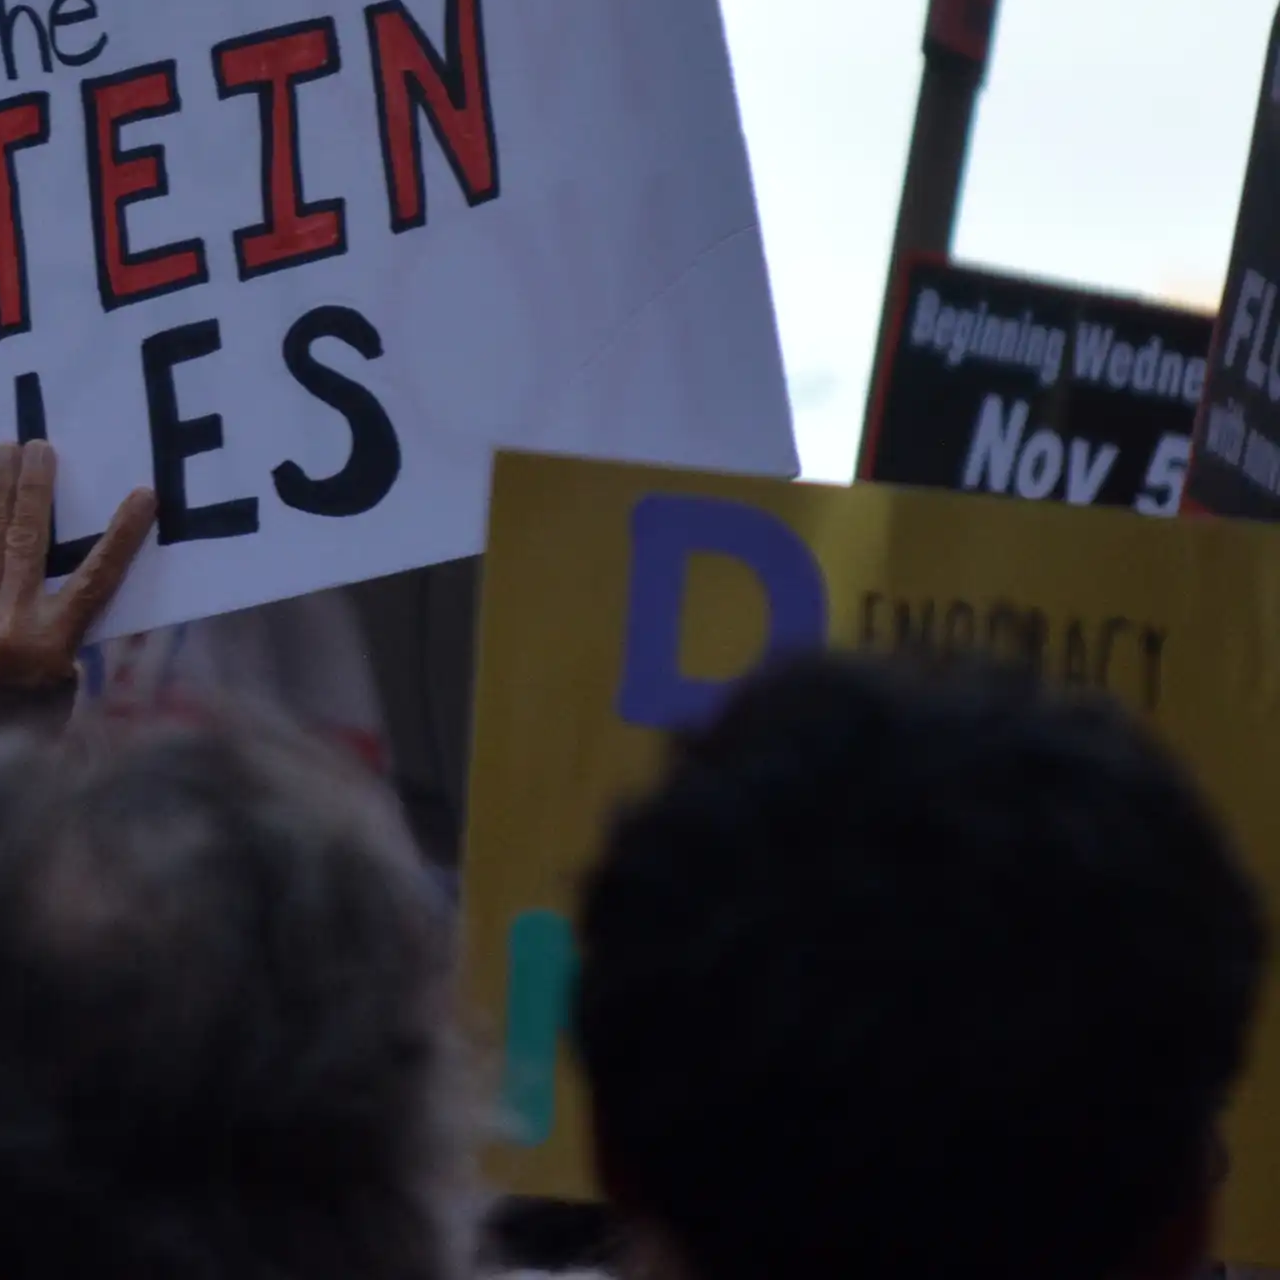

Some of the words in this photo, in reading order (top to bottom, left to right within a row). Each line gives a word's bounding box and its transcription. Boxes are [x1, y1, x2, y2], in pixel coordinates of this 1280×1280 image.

[912, 288, 1066, 386] Beginning
[962, 393, 1120, 506] Nov
[1135, 432, 1192, 517] 5
